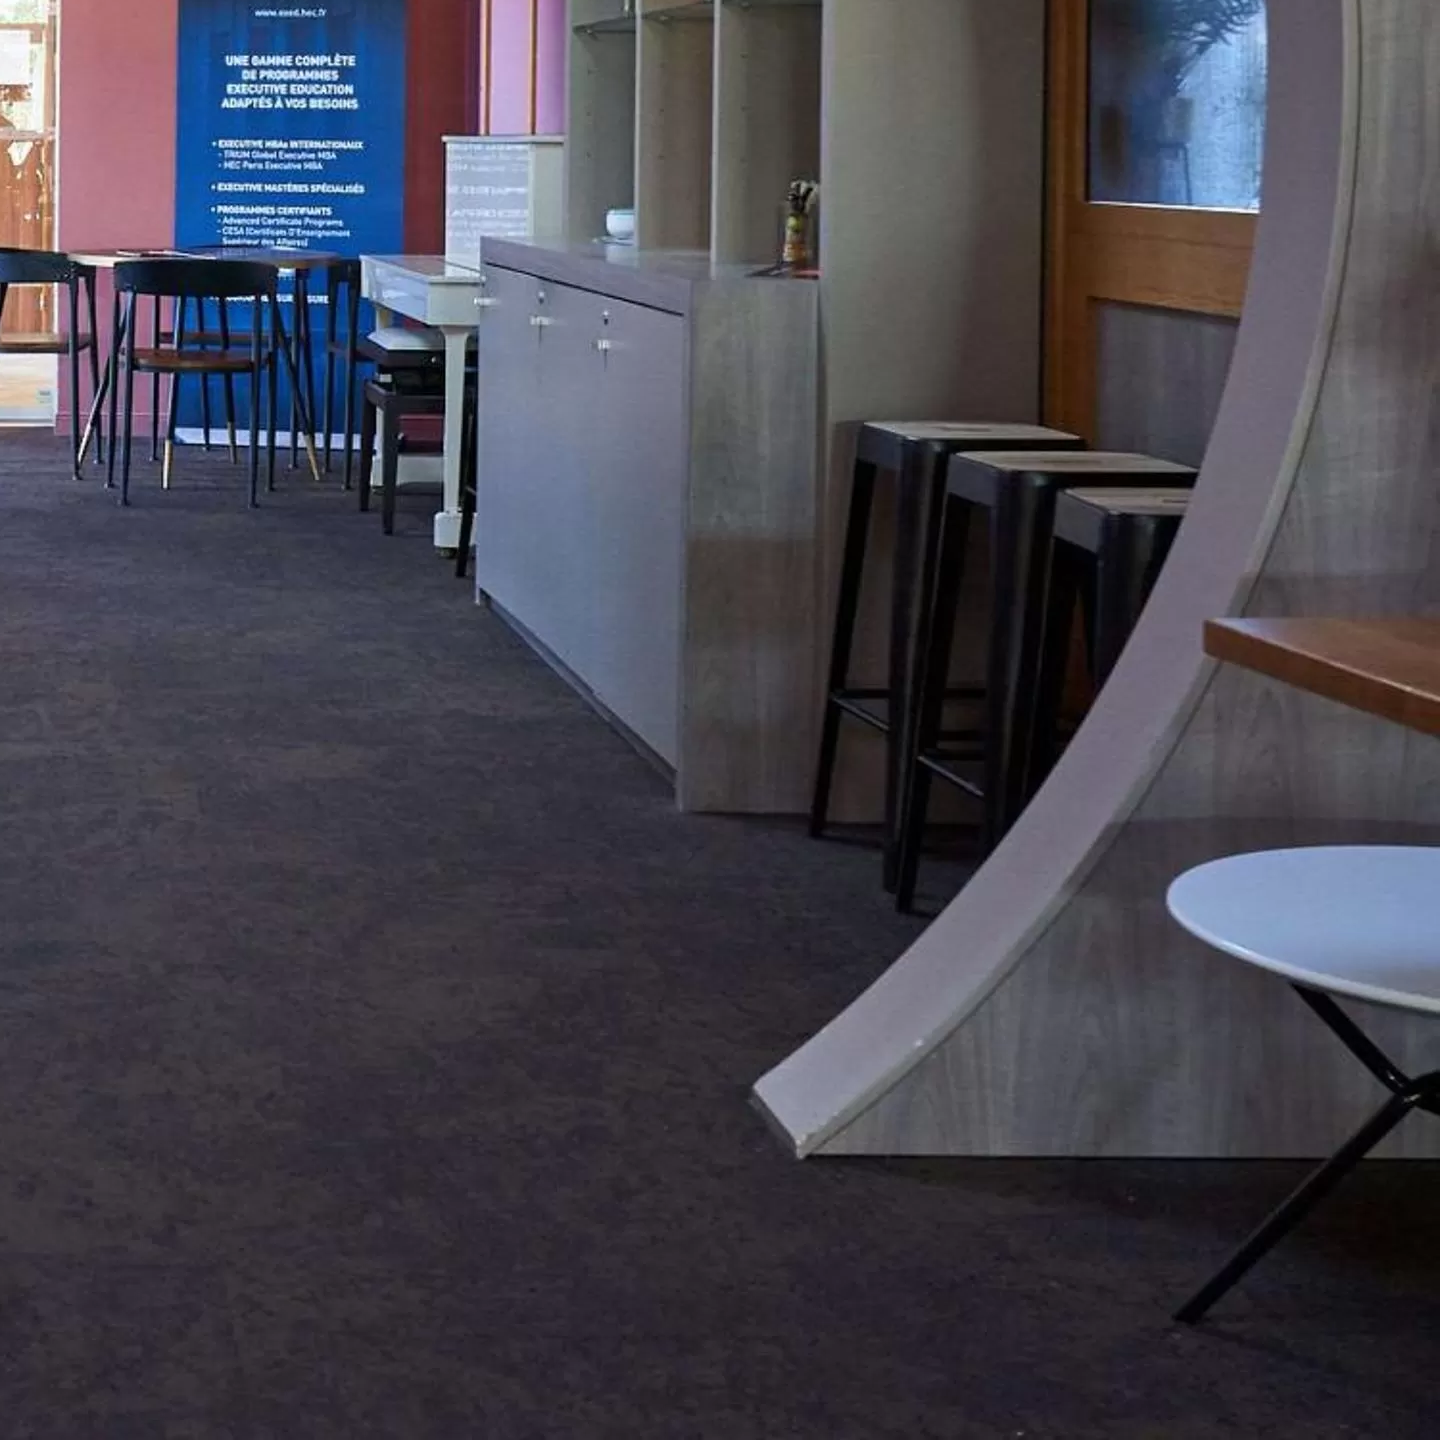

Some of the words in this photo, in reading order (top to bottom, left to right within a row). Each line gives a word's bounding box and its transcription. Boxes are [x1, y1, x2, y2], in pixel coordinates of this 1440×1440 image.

[225, 55, 250, 66] UNE
[251, 55, 293, 66] GAMME
[295, 53, 356, 66] COMPLÈTE
[242, 70, 257, 80] DE
[259, 70, 339, 81] PROGRAMMES
[226, 84, 287, 95] EXECUTIVE
[290, 84, 354, 95] EDUCATION
[221, 96, 273, 108] ADAPTÉS
[274, 96, 283, 108] À
[286, 99, 307, 108] VOS
[309, 99, 359, 109] BESOINS
